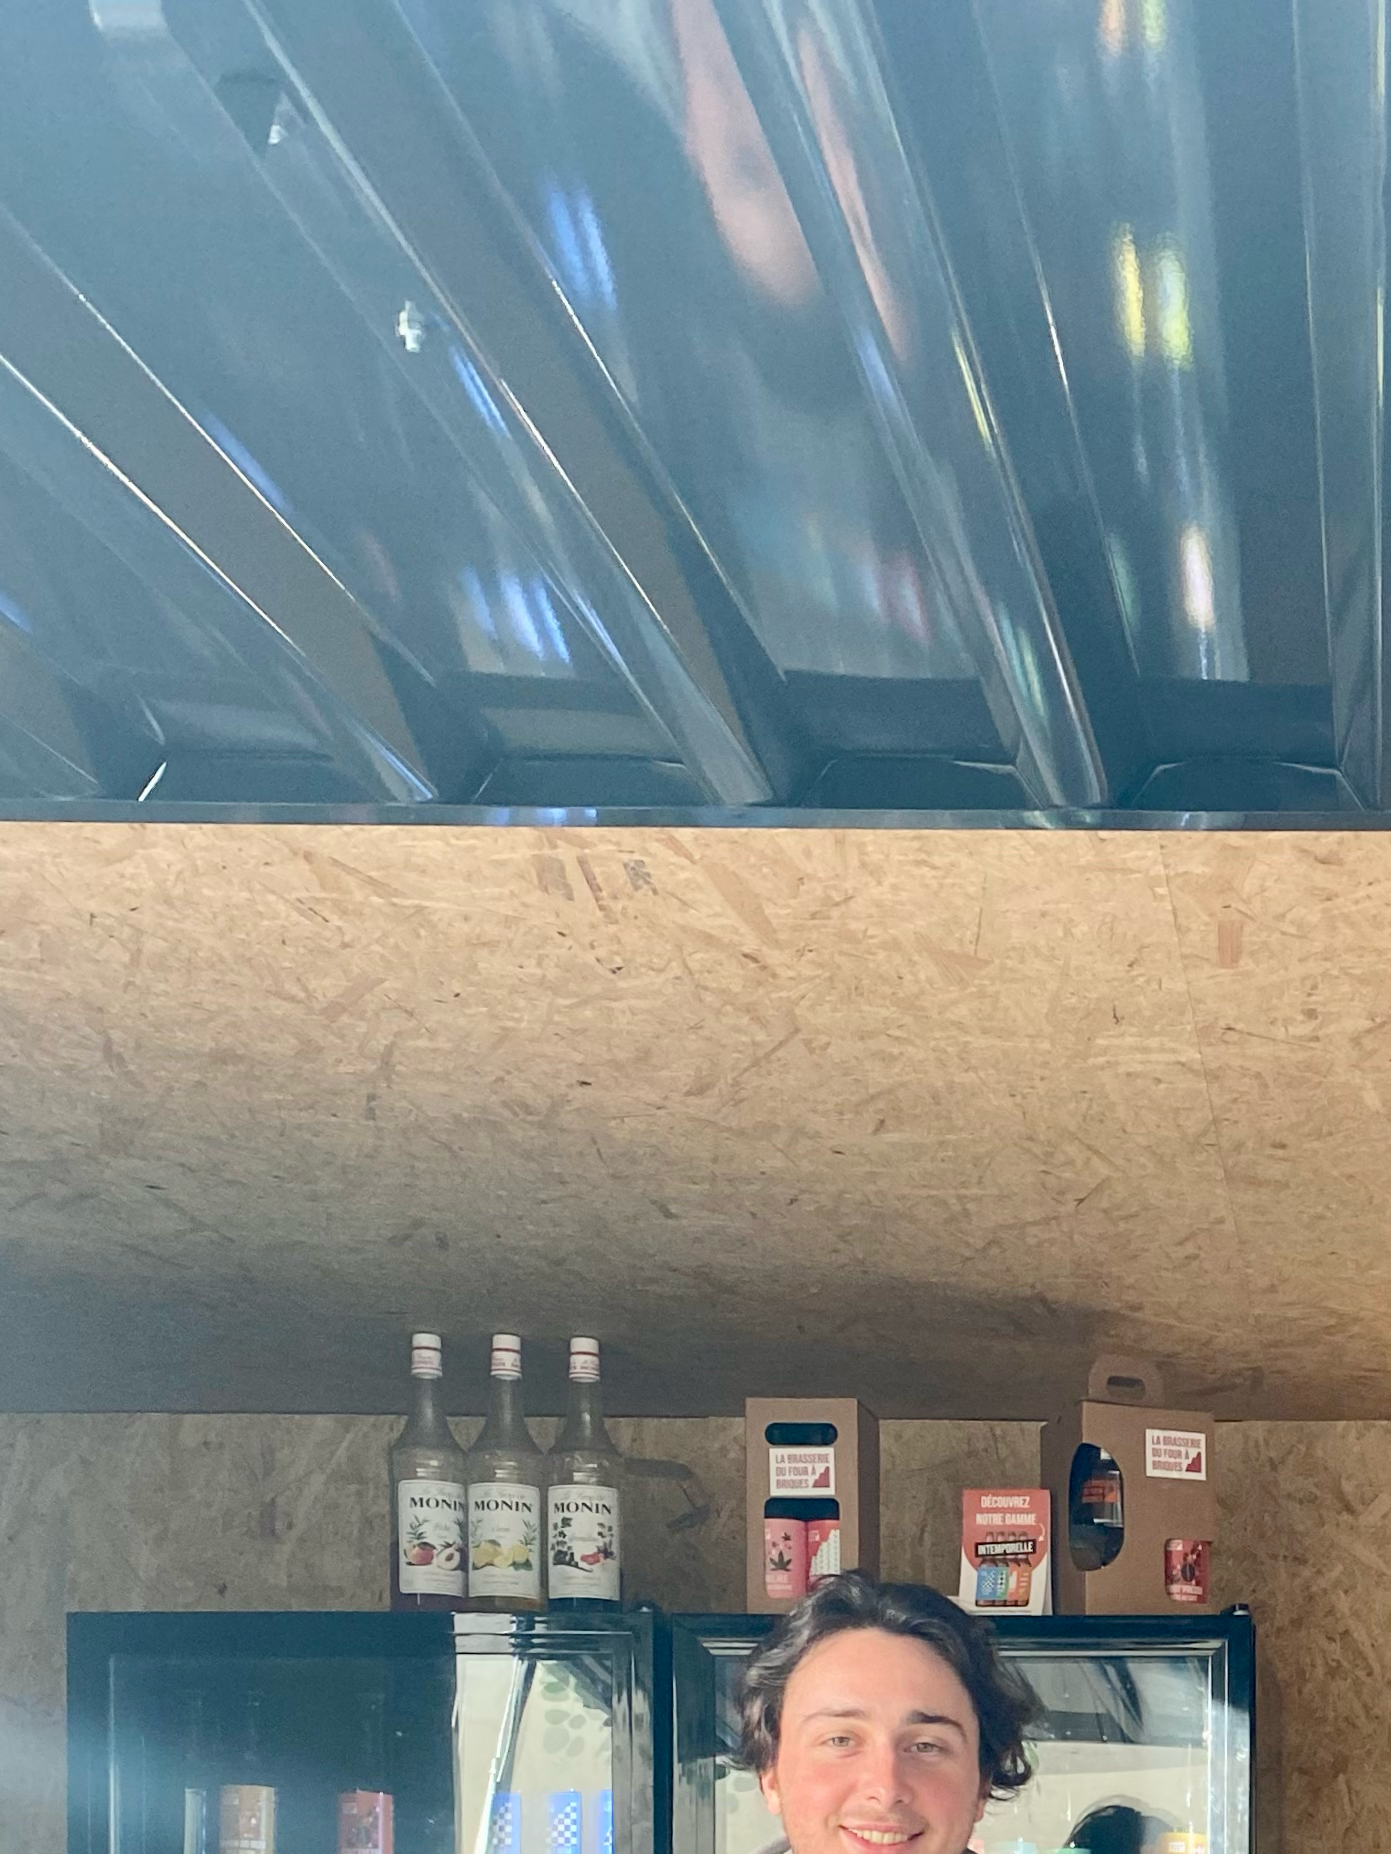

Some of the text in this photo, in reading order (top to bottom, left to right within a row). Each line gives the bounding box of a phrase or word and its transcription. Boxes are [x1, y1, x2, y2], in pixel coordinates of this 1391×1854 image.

[1152, 1435, 1202, 1449] LA BRASSERIE
[775, 1453, 830, 1464] LA BRASSERIE
[1152, 1448, 1162, 1458] DU
[1164, 1449, 1182, 1459] FOUR
[776, 1467, 786, 1477] DU
[788, 1467, 808, 1477] FOUR
[1152, 1460, 1183, 1472] BRIQUES
[776, 1479, 809, 1489] BRIQUES
[409, 1497, 464, 1512] MONIN
[474, 1499, 533, 1514] MONIN
[981, 1494, 1030, 1508] DÉCOUVREZ
[553, 1502, 612, 1515] MONIN
[976, 1513, 1037, 1525] NOTRE GAMME
